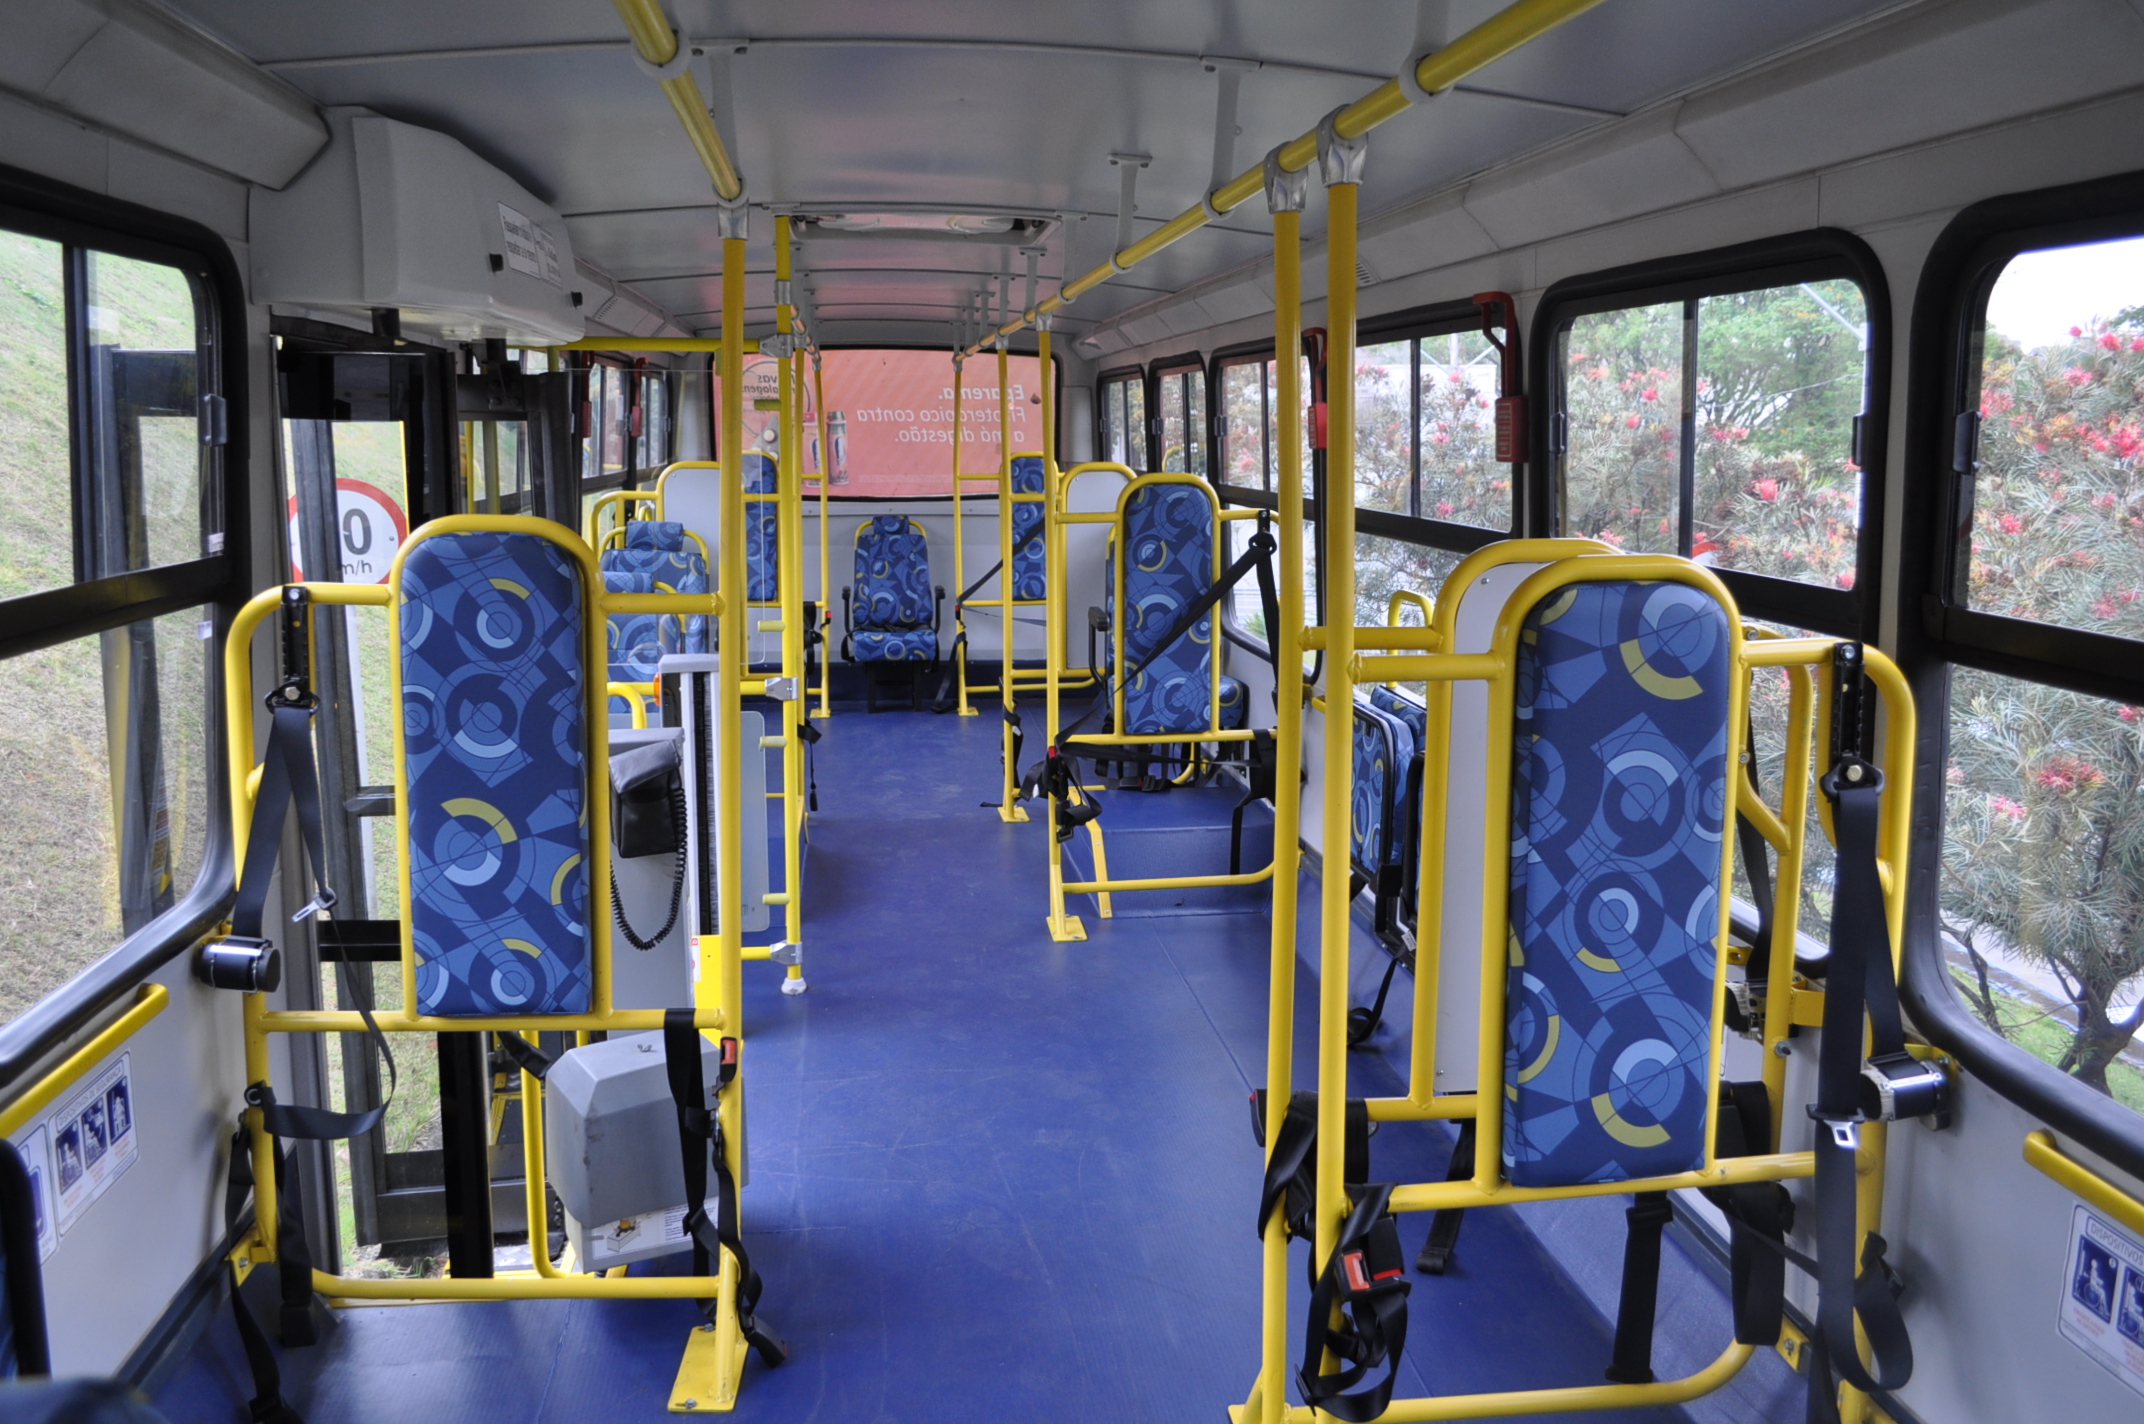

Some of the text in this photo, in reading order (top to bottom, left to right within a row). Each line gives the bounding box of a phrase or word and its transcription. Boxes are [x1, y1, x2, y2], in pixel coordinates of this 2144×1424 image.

[342, 508, 372, 556] 0
[341, 559, 373, 576] m/h
[2091, 1223, 2144, 1266] DISPOSITIVOS
